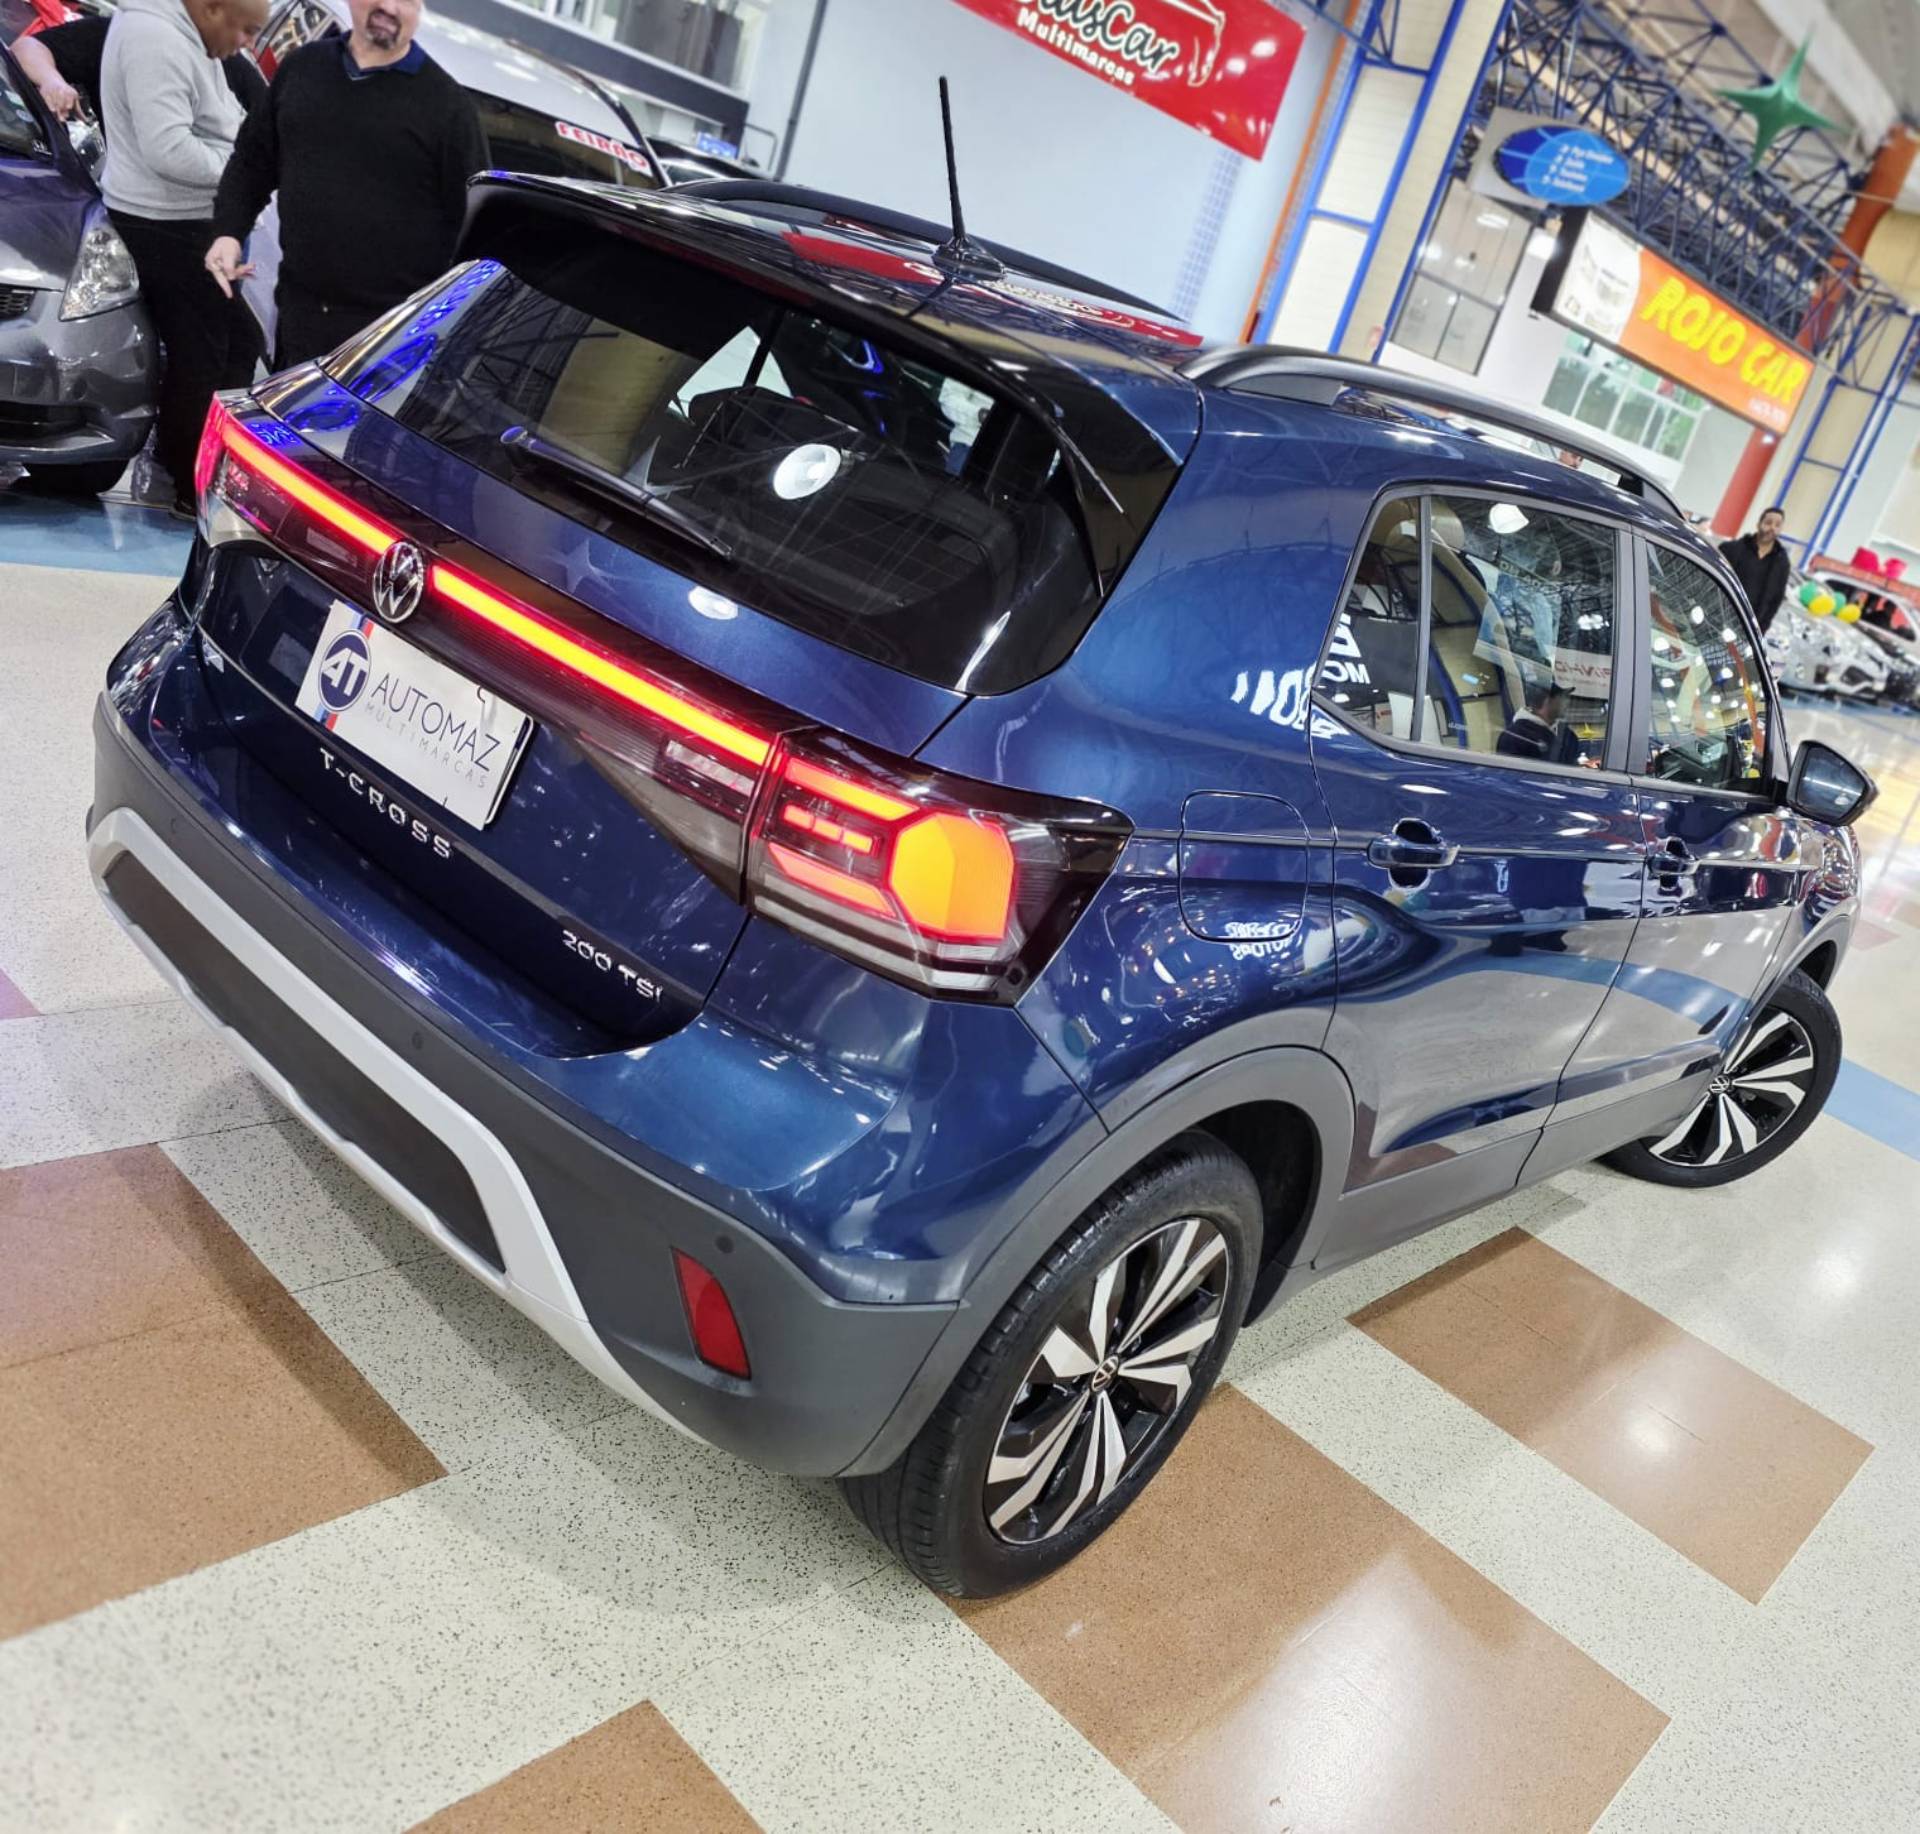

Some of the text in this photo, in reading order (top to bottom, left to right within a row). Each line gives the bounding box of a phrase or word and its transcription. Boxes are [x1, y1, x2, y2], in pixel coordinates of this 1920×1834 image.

[1640, 275, 1807, 404] ROJO CAR
[364, 701, 488, 789] MULTIMARCAS
[370, 673, 501, 772] AUTOMAZ
[320, 747, 451, 860] T-CROSS
[563, 929, 664, 1002] 200 TSI
